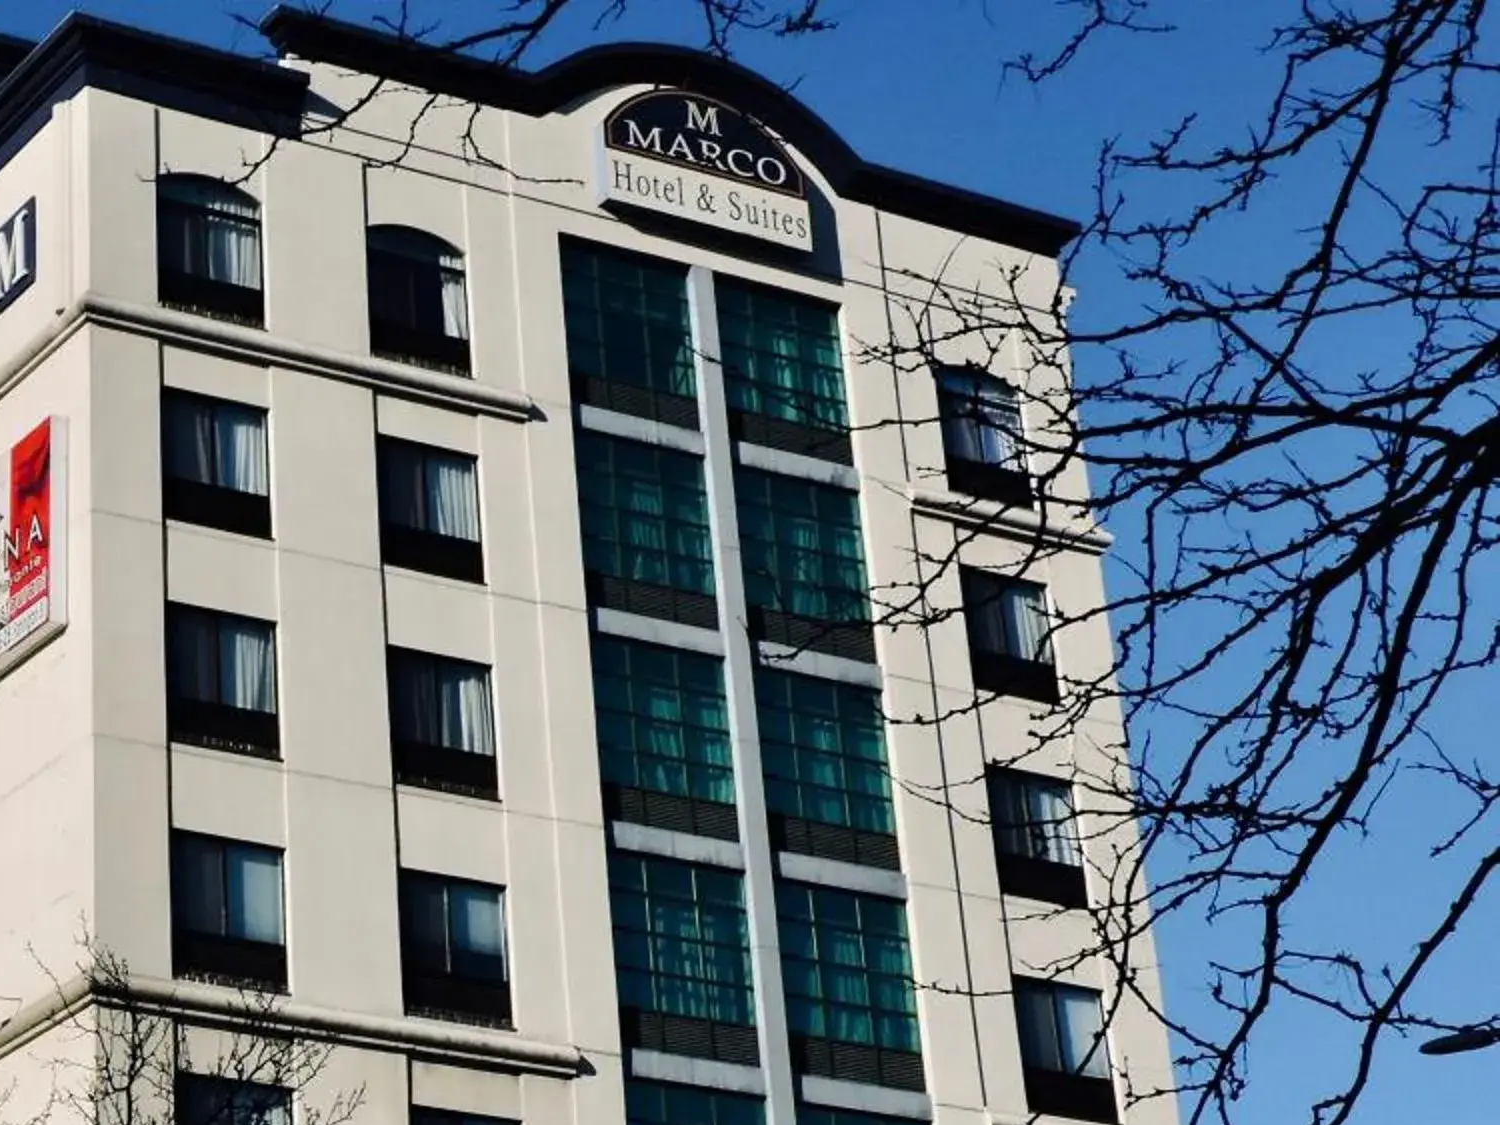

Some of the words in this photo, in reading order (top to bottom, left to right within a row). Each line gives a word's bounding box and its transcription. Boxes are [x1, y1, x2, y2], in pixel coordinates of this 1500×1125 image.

[684, 100, 723, 137] M
[624, 119, 787, 185] MARCO
[611, 159, 684, 206] Hotel
[697, 183, 717, 214] &
[728, 191, 807, 239] Suites
